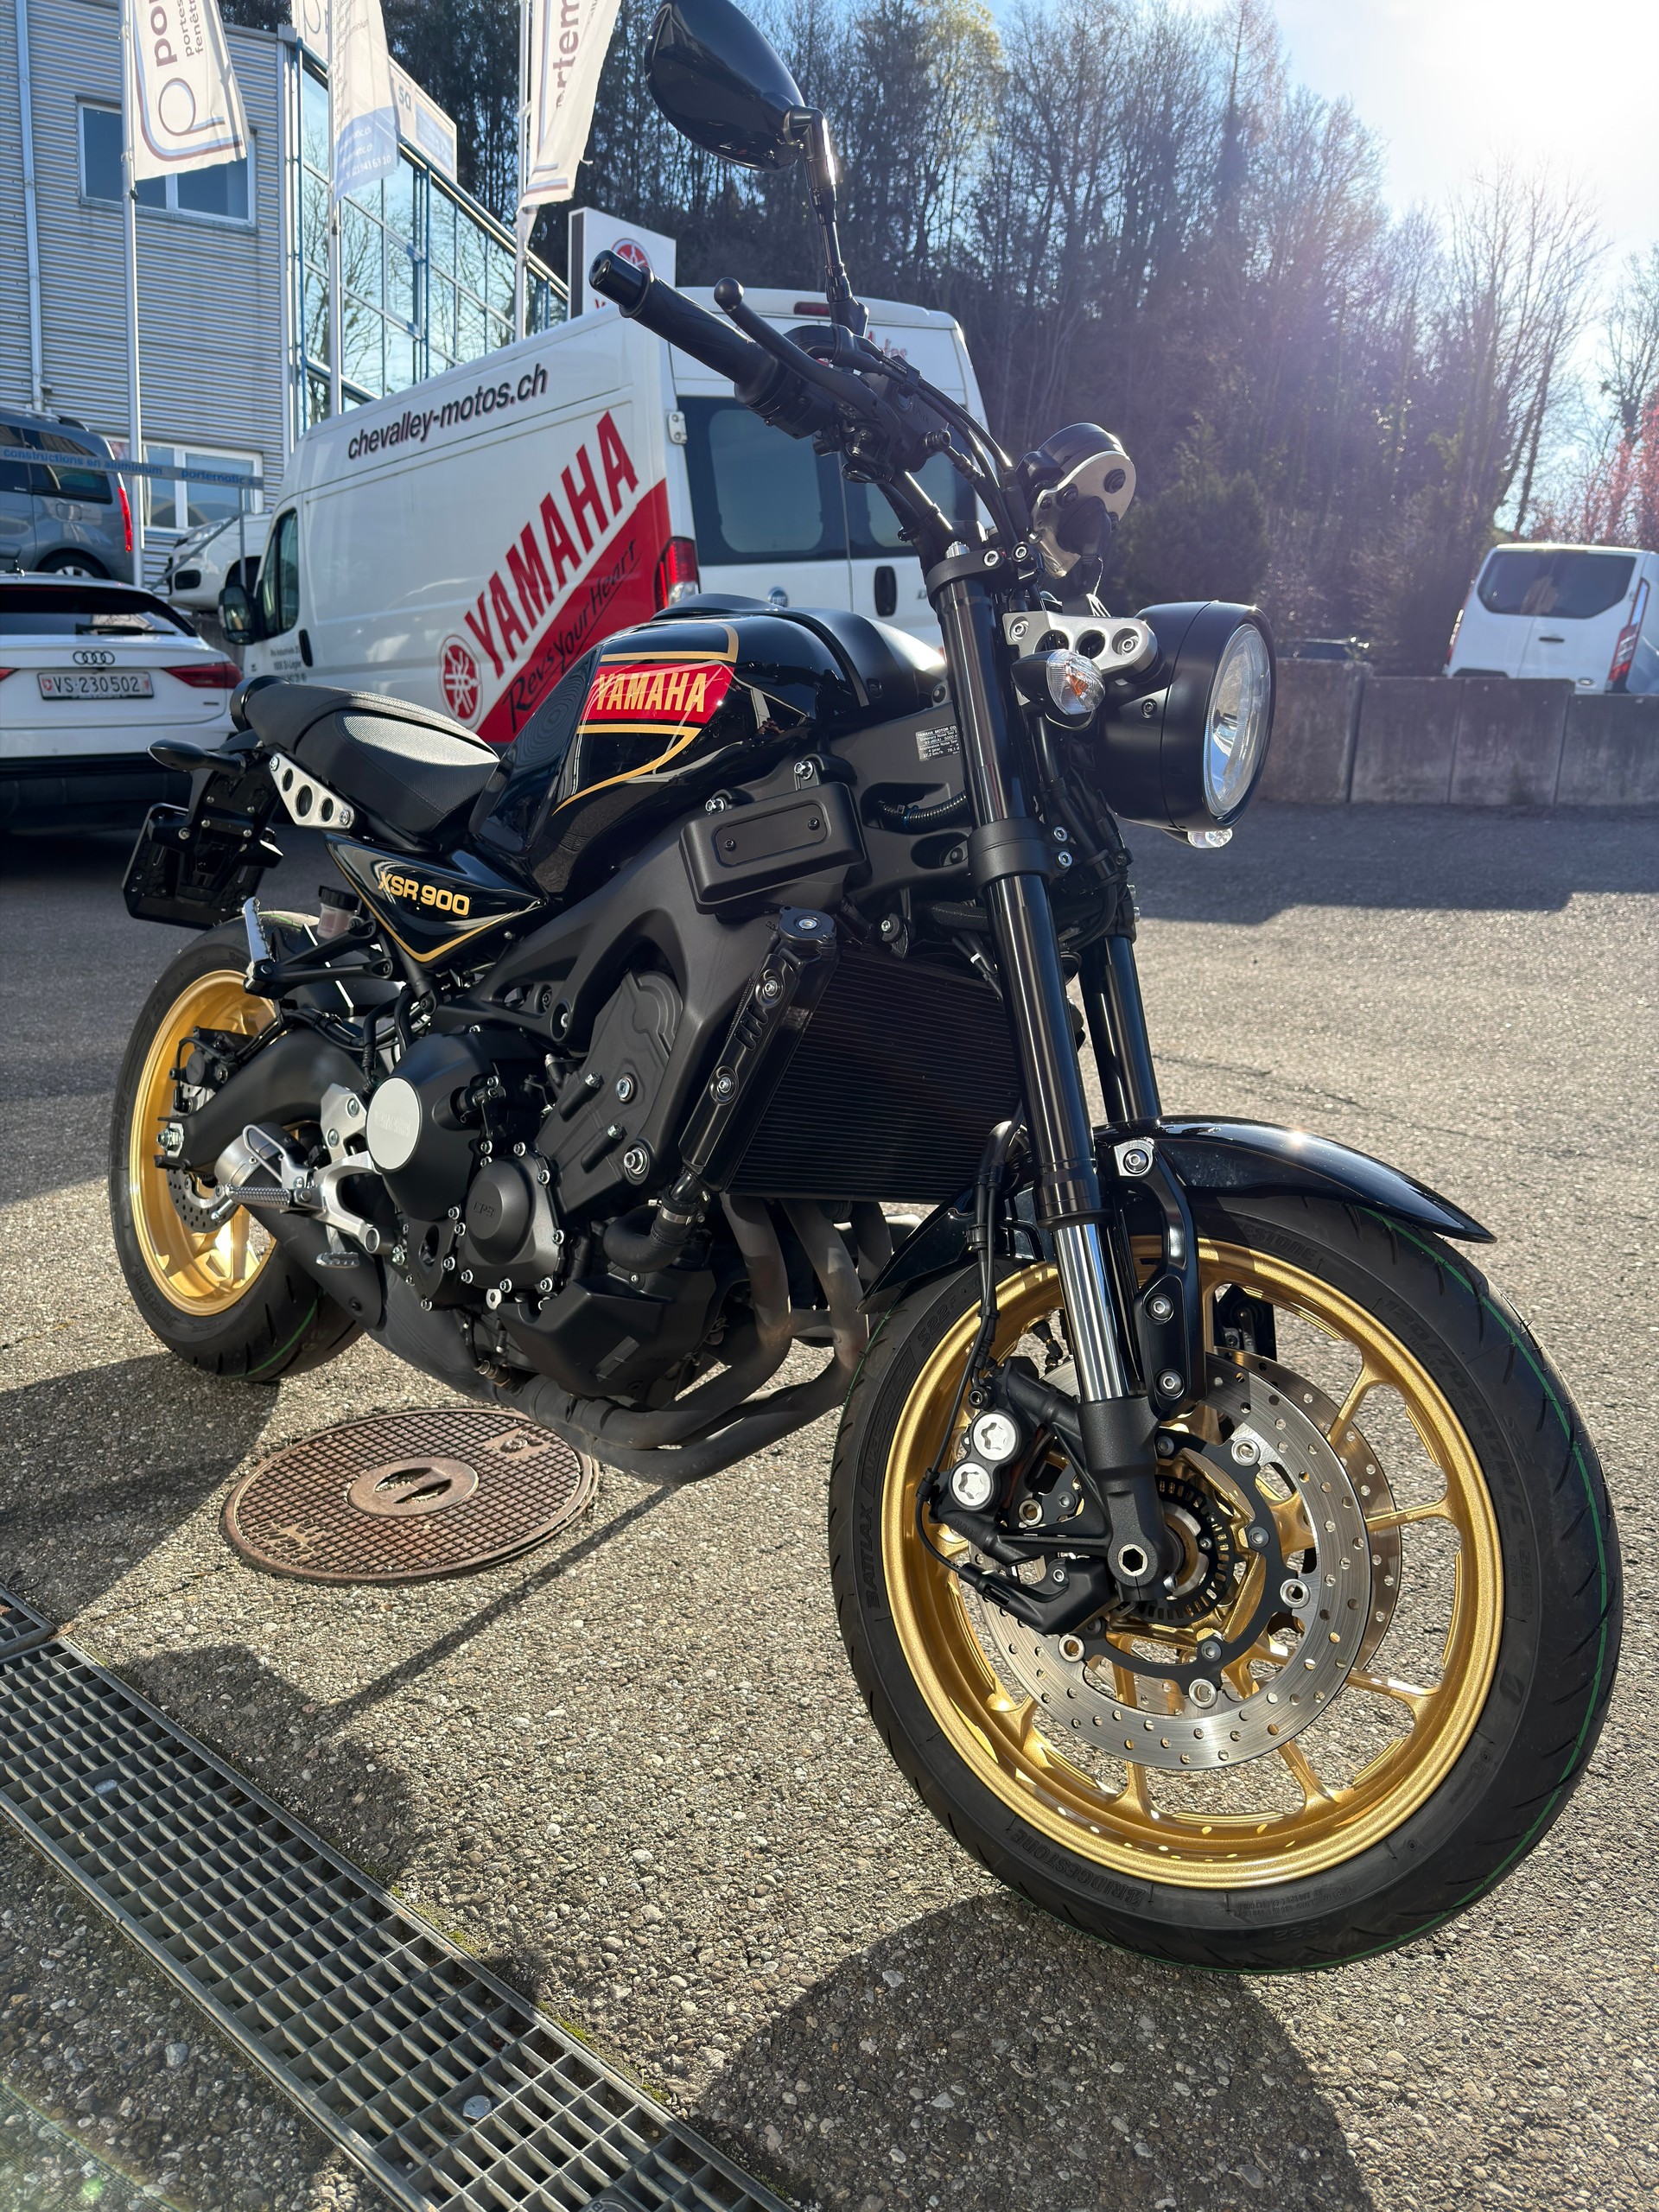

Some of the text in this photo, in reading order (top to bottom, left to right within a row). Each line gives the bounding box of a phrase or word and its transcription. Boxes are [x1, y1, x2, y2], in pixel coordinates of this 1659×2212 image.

[149, 0, 178, 67] po
[347, 363, 549, 461] chevalley-motos.ch
[3, 448, 84, 467] constructions
[86, 459, 102, 469] en
[104, 460, 163, 476] aluminium
[464, 410, 639, 680] YAMAHA
[502, 646, 556, 734] Revs
[552, 612, 593, 677] Your
[594, 672, 707, 714] YAMAHA
[857, 1505, 881, 1610] BATTLAX
[1008, 1827, 1147, 1909] BRIDGESTONE
